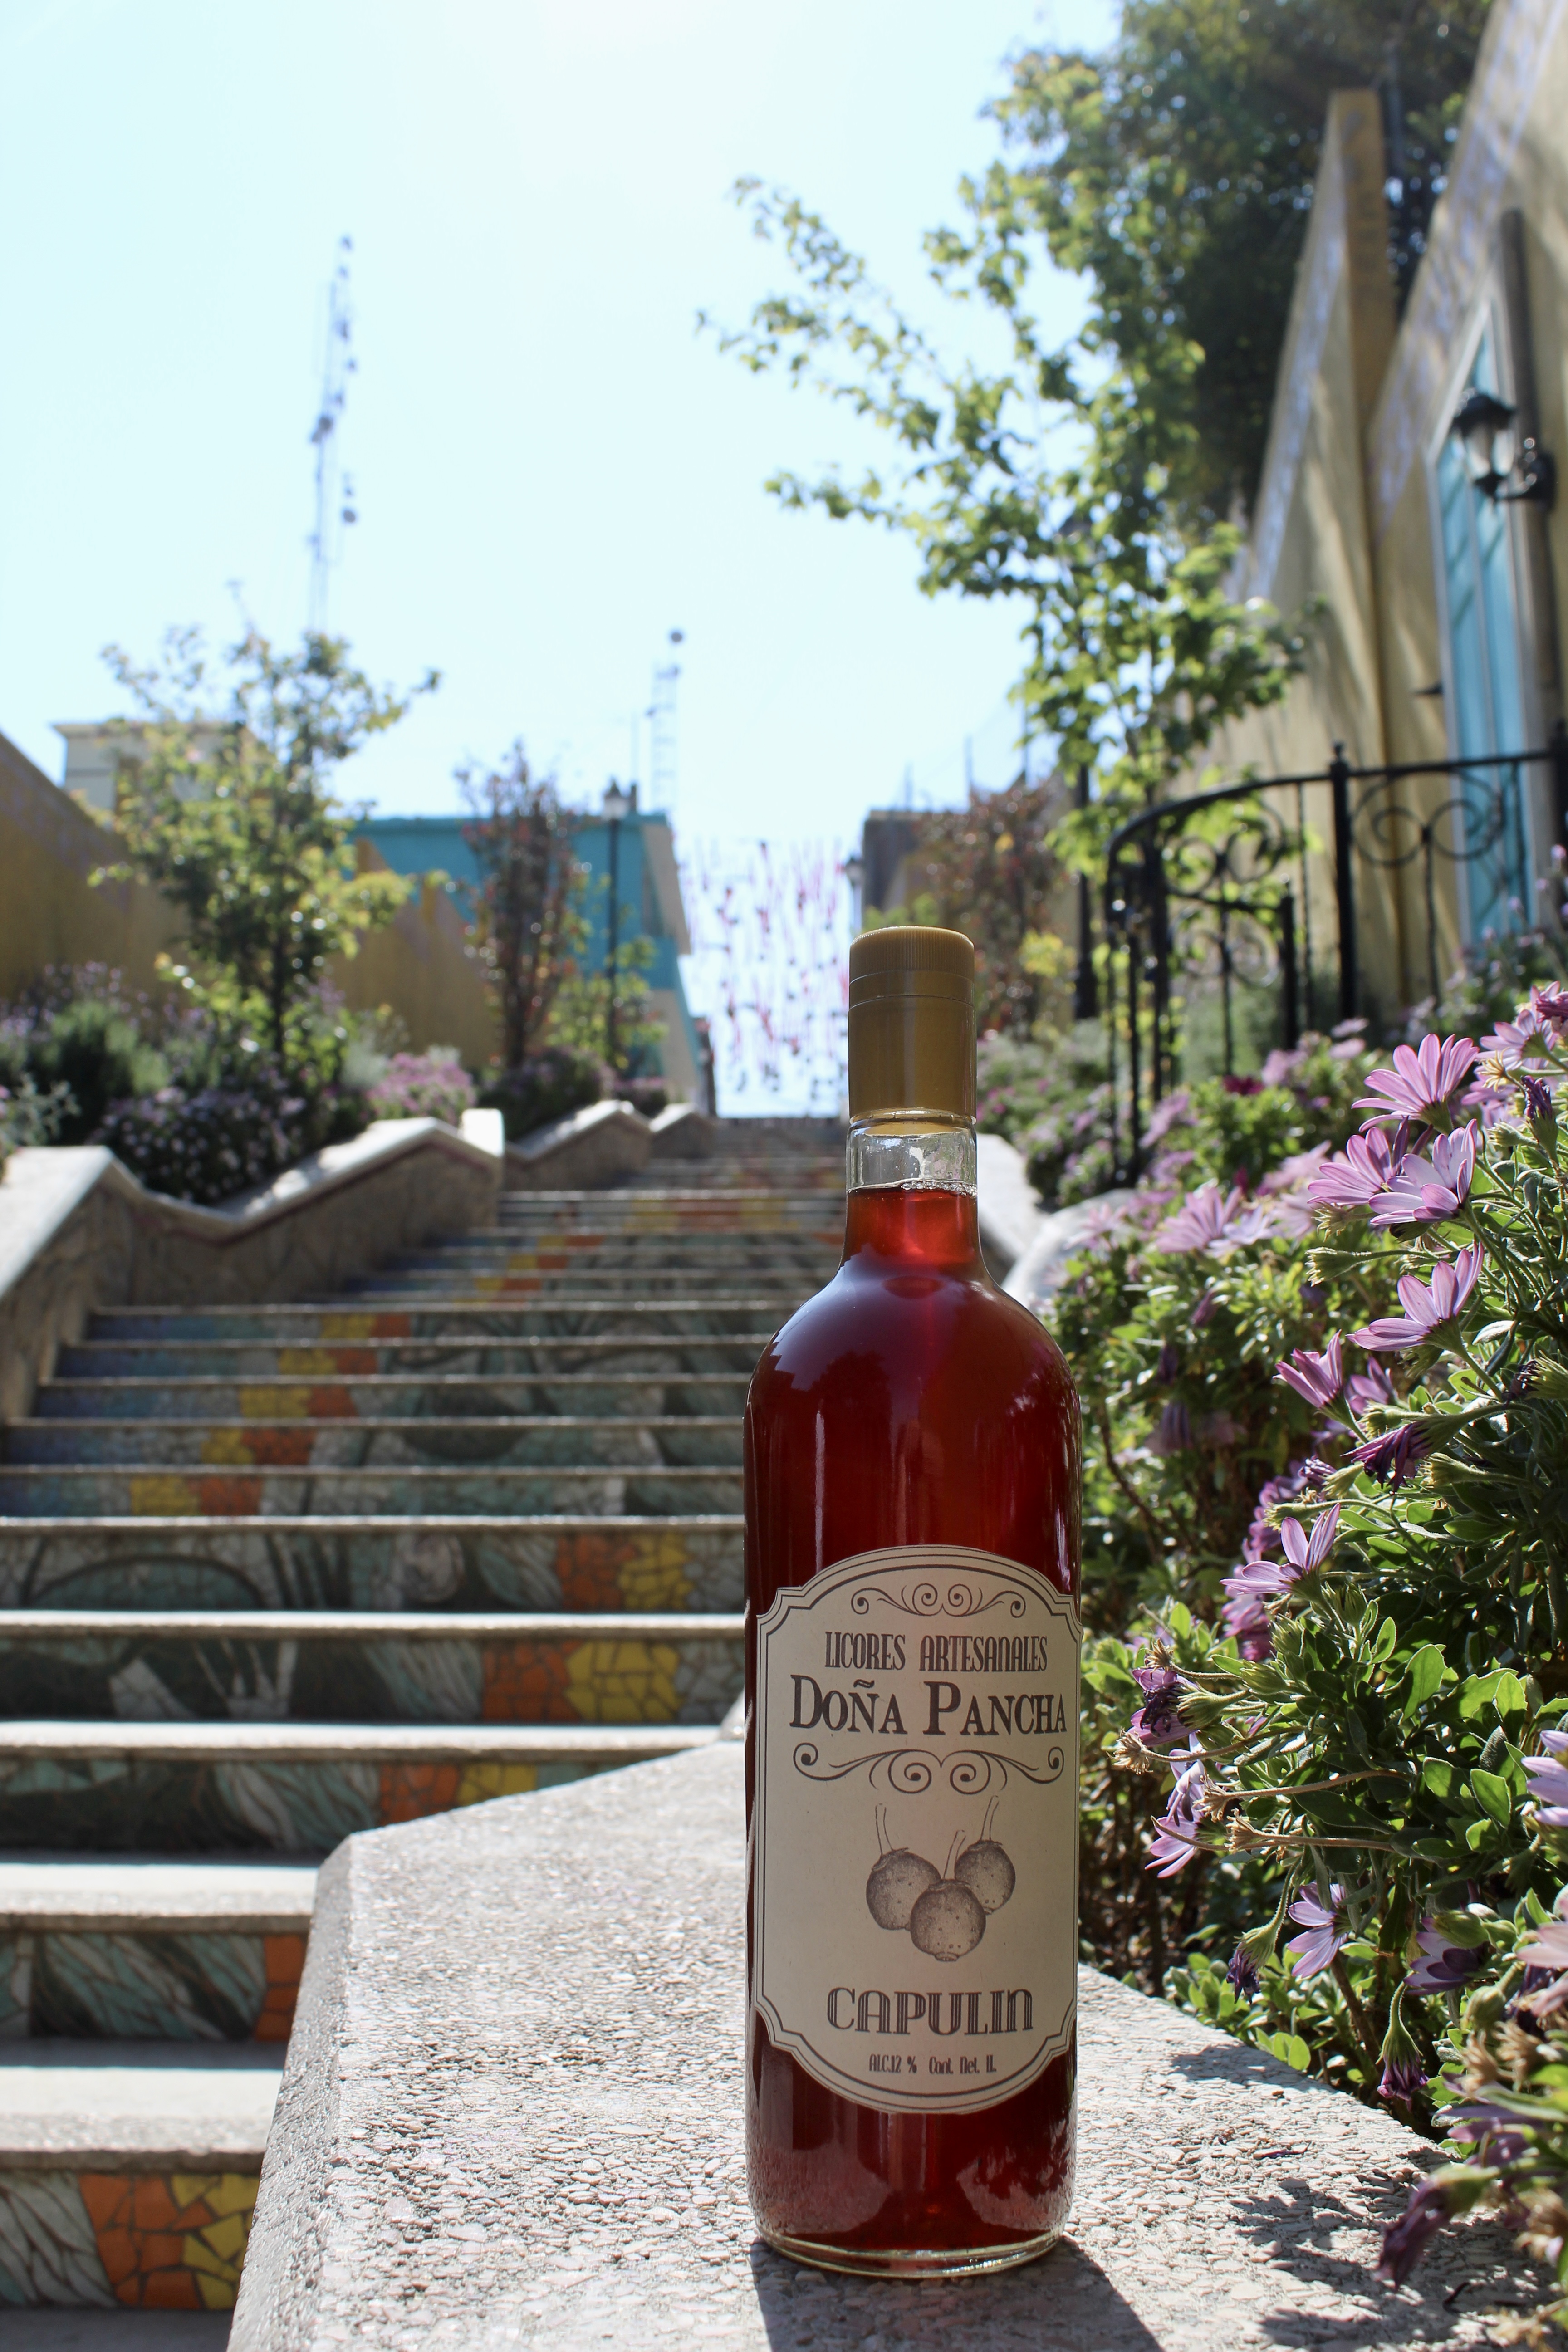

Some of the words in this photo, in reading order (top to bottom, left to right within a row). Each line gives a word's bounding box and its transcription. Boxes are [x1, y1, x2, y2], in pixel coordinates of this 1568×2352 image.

[824, 1632, 906, 1670] LICORES
[919, 1635, 1048, 1672] ARTESANALES
[827, 1987, 1034, 2036] CAPULIN
[907, 2055, 917, 2073] %
[960, 2056, 980, 2073] Net.
